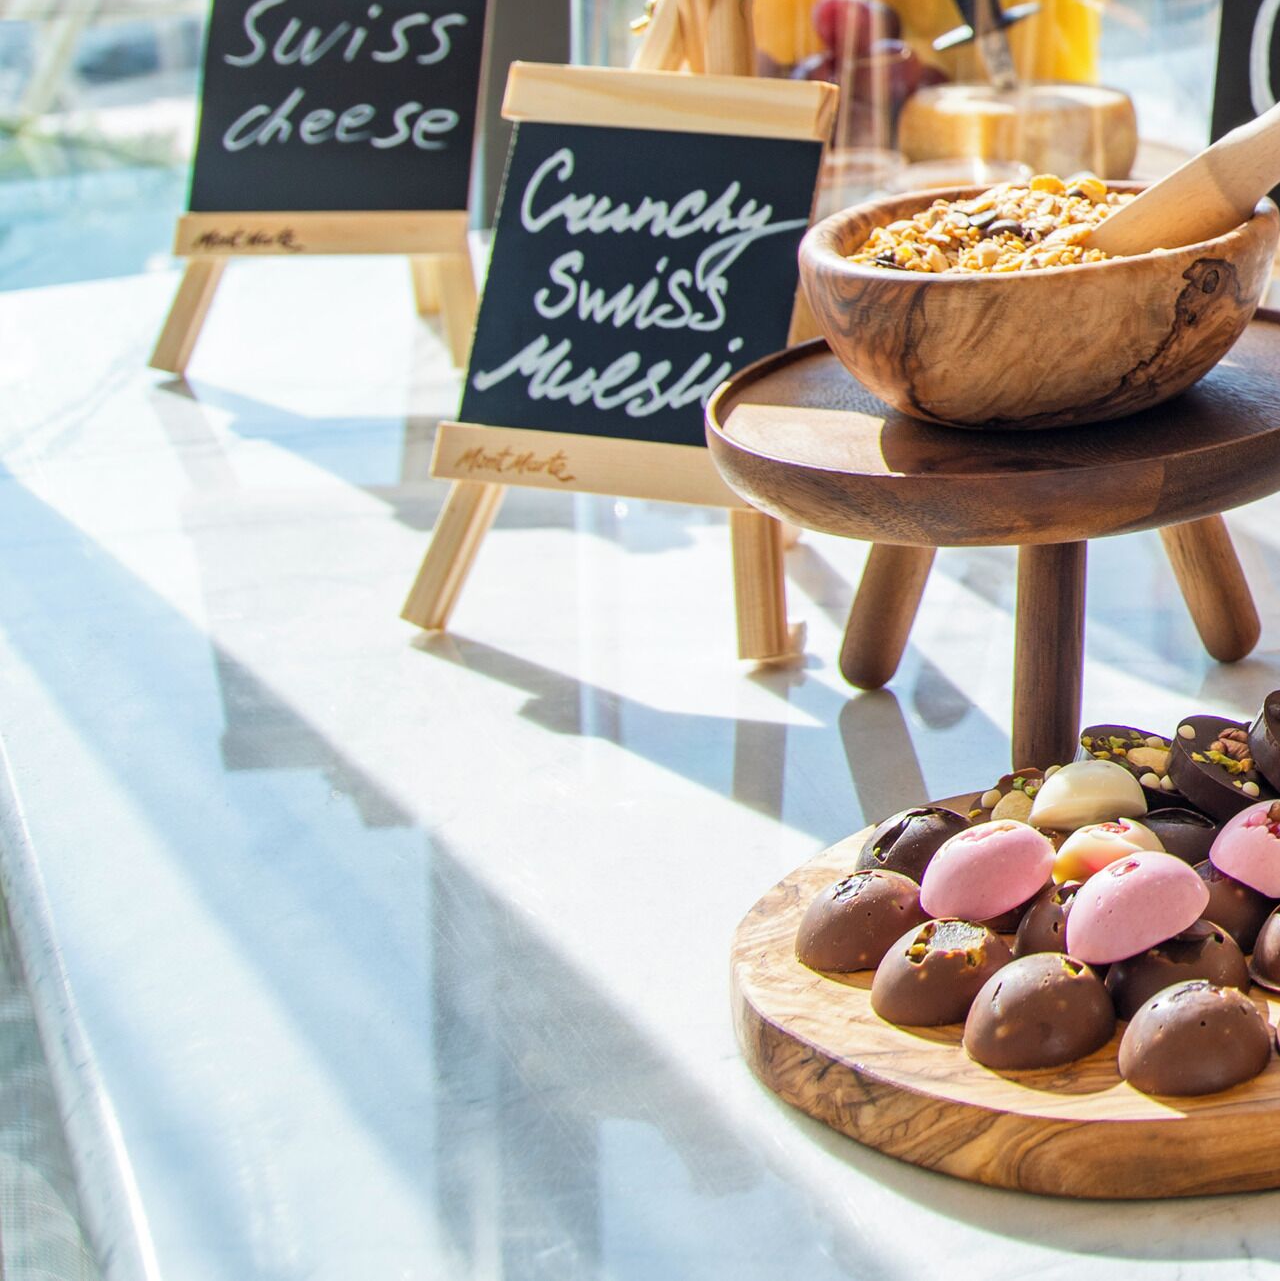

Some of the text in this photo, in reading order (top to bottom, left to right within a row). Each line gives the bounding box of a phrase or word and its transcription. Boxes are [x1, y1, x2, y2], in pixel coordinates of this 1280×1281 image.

[222, 86, 460, 152] cheese
[520, 147, 808, 292] Crunchy
[533, 249, 729, 332] Swiss
[472, 335, 745, 418] Muesli
